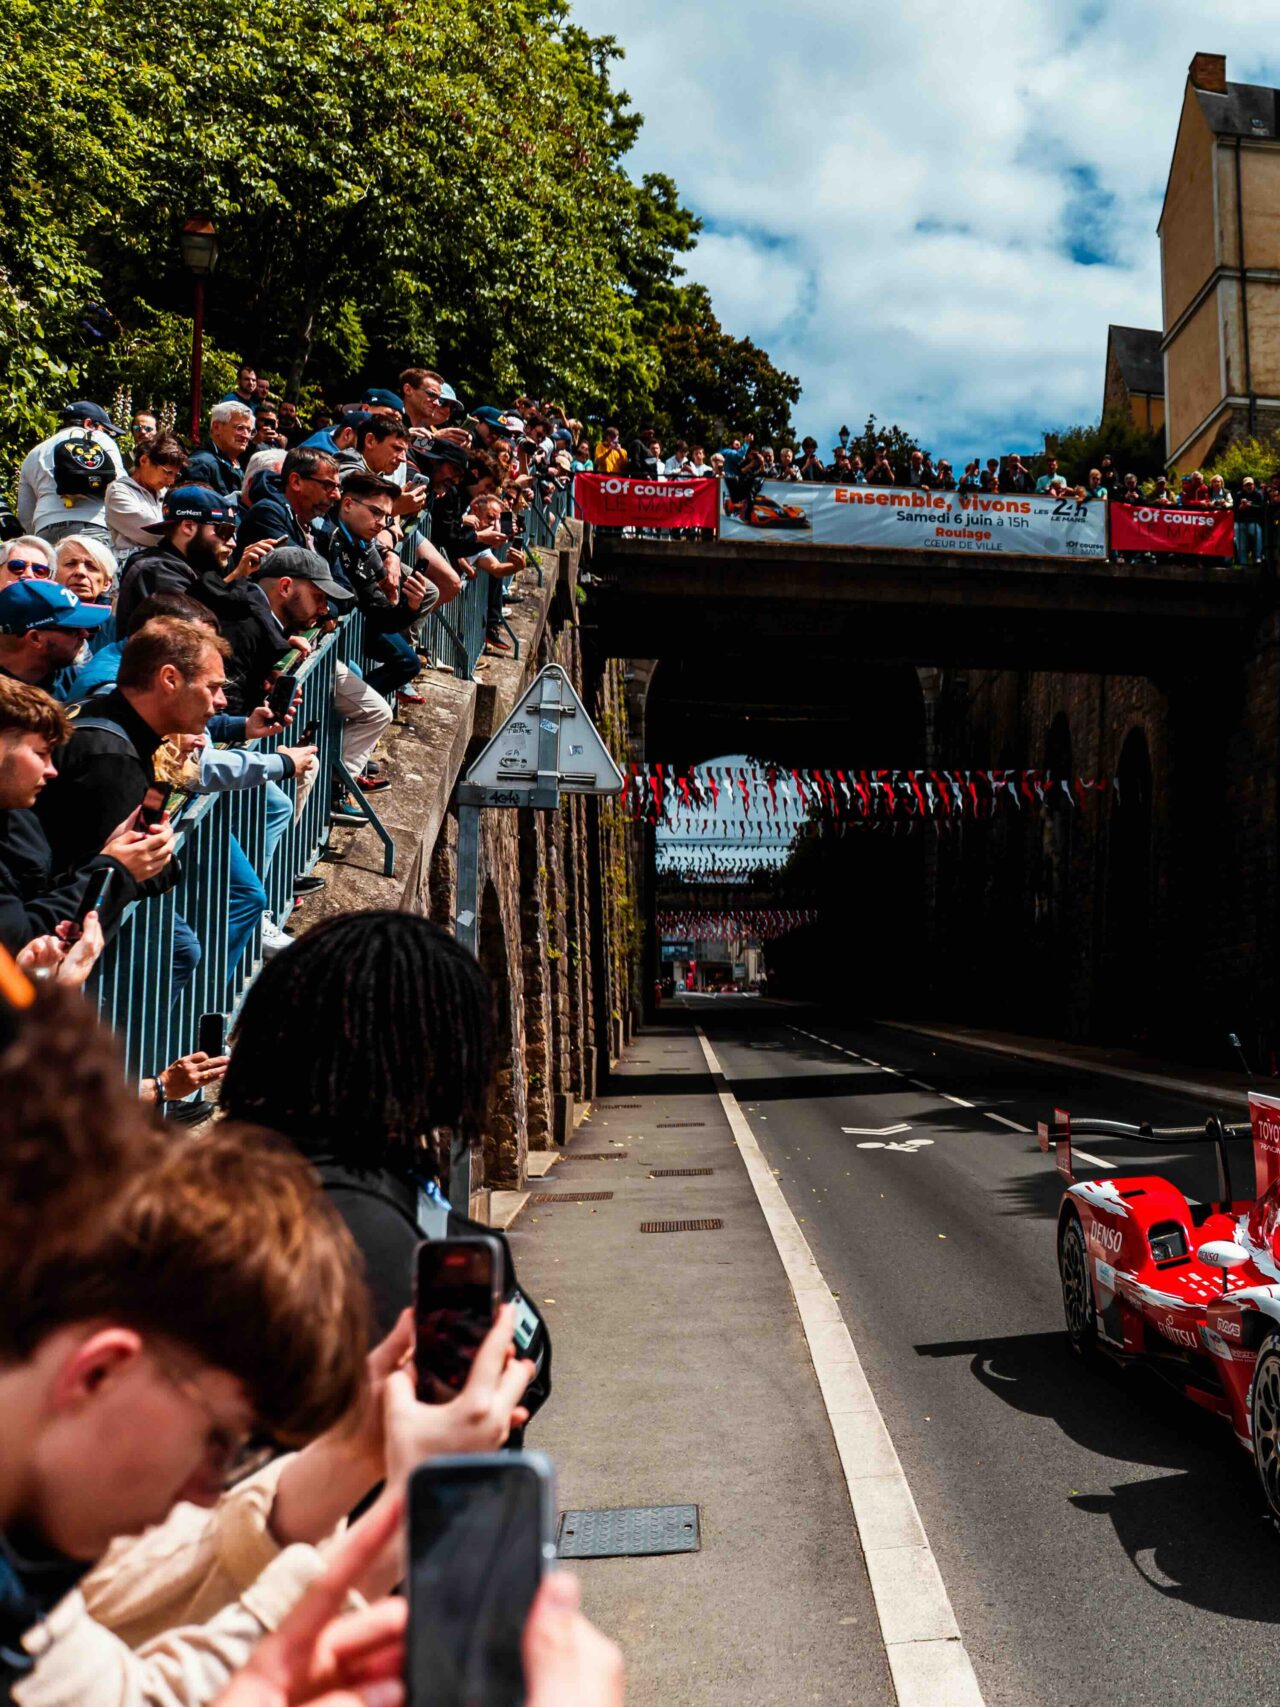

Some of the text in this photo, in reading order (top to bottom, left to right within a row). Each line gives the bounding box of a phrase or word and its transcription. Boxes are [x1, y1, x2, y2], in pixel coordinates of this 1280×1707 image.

[600, 479, 695, 498] :Of course
[605, 495, 696, 513] LE MANS
[834, 488, 1031, 514] Ensemble, vivons
[897, 511, 1029, 528] Samedi 6 juin à 15h
[1133, 509, 1214, 526] :Of course
[935, 527, 992, 541] Roulage
[959, 540, 972, 549] DE
[975, 541, 1003, 551] VILLE
[1090, 1220, 1123, 1253] DENSO
[1199, 1250, 1219, 1262] DENSO
